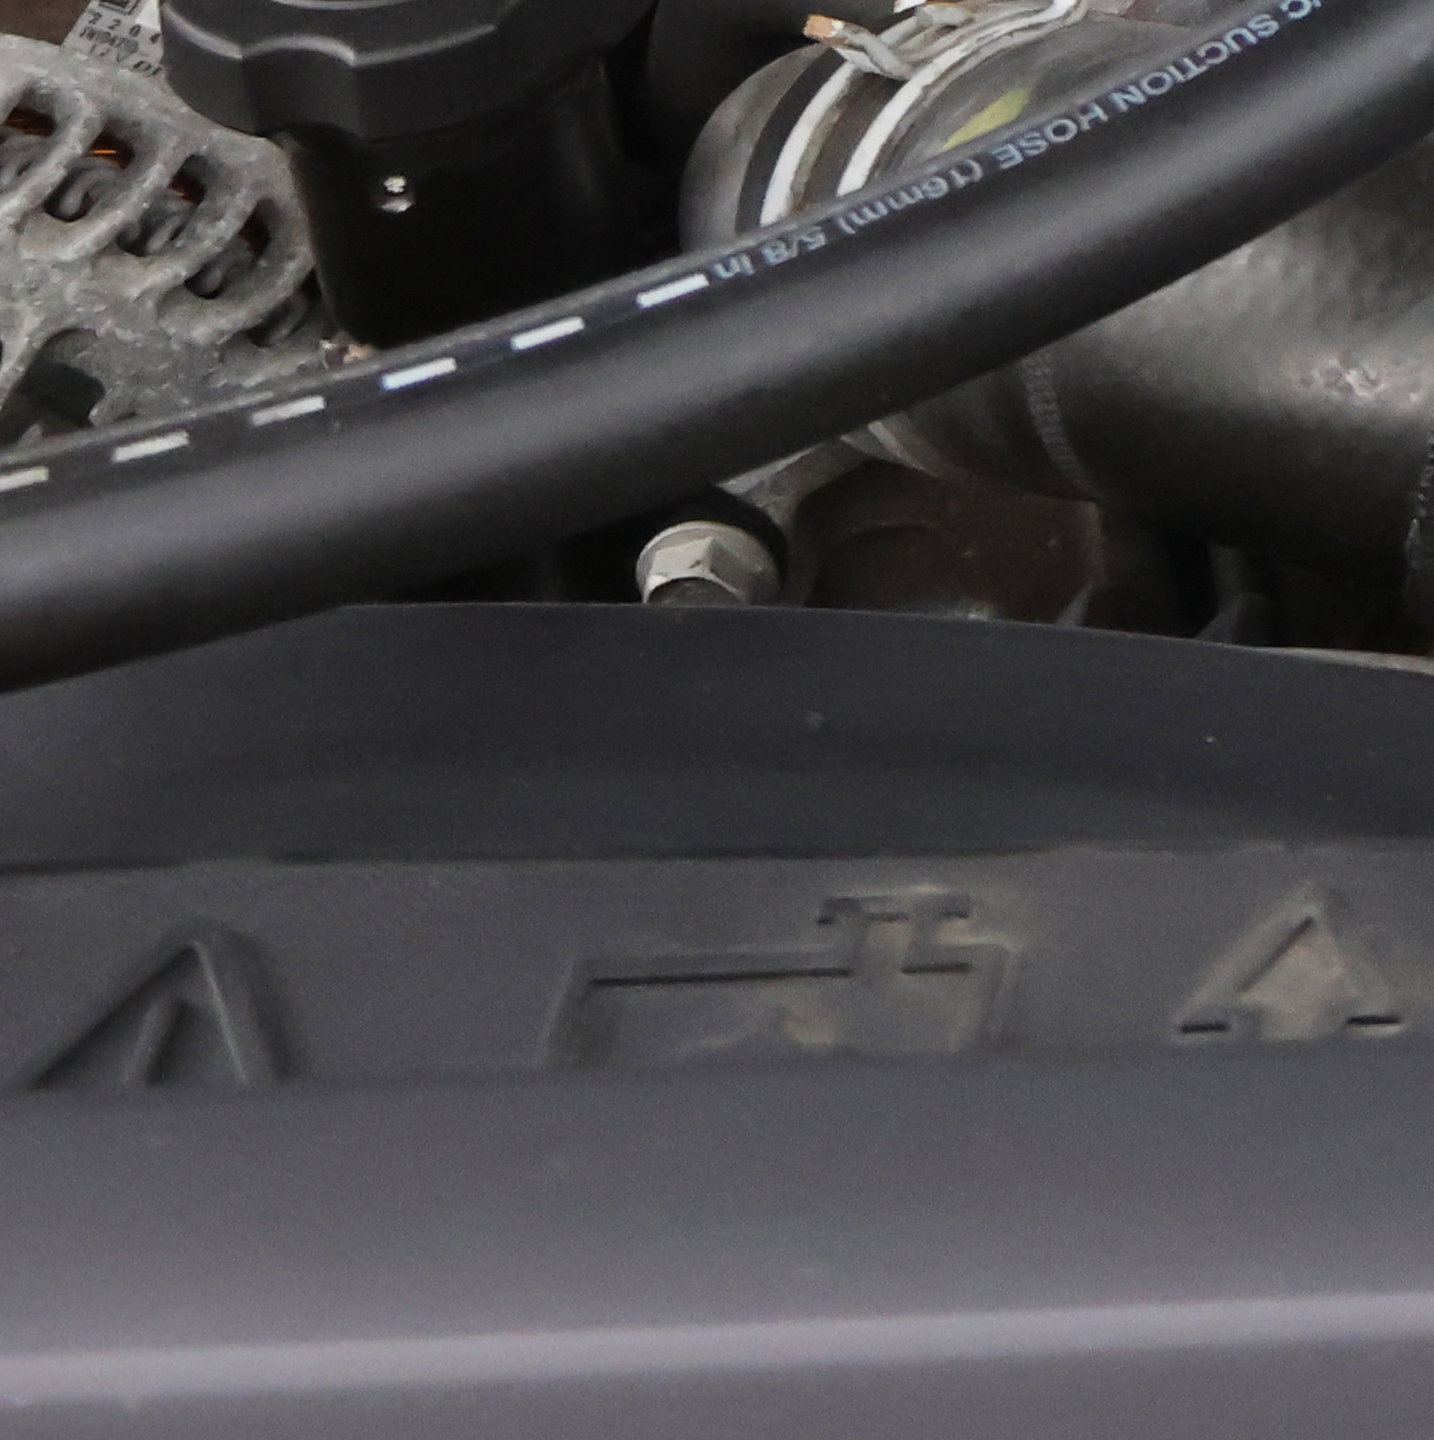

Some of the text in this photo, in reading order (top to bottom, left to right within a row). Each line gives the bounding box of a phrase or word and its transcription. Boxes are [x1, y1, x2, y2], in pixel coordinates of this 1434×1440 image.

[1114, 13, 1280, 113] SUCTION
[997, 99, 1110, 169] HOSE
[841, 160, 984, 235] (16mm)
[761, 225, 828, 266] 5/8
